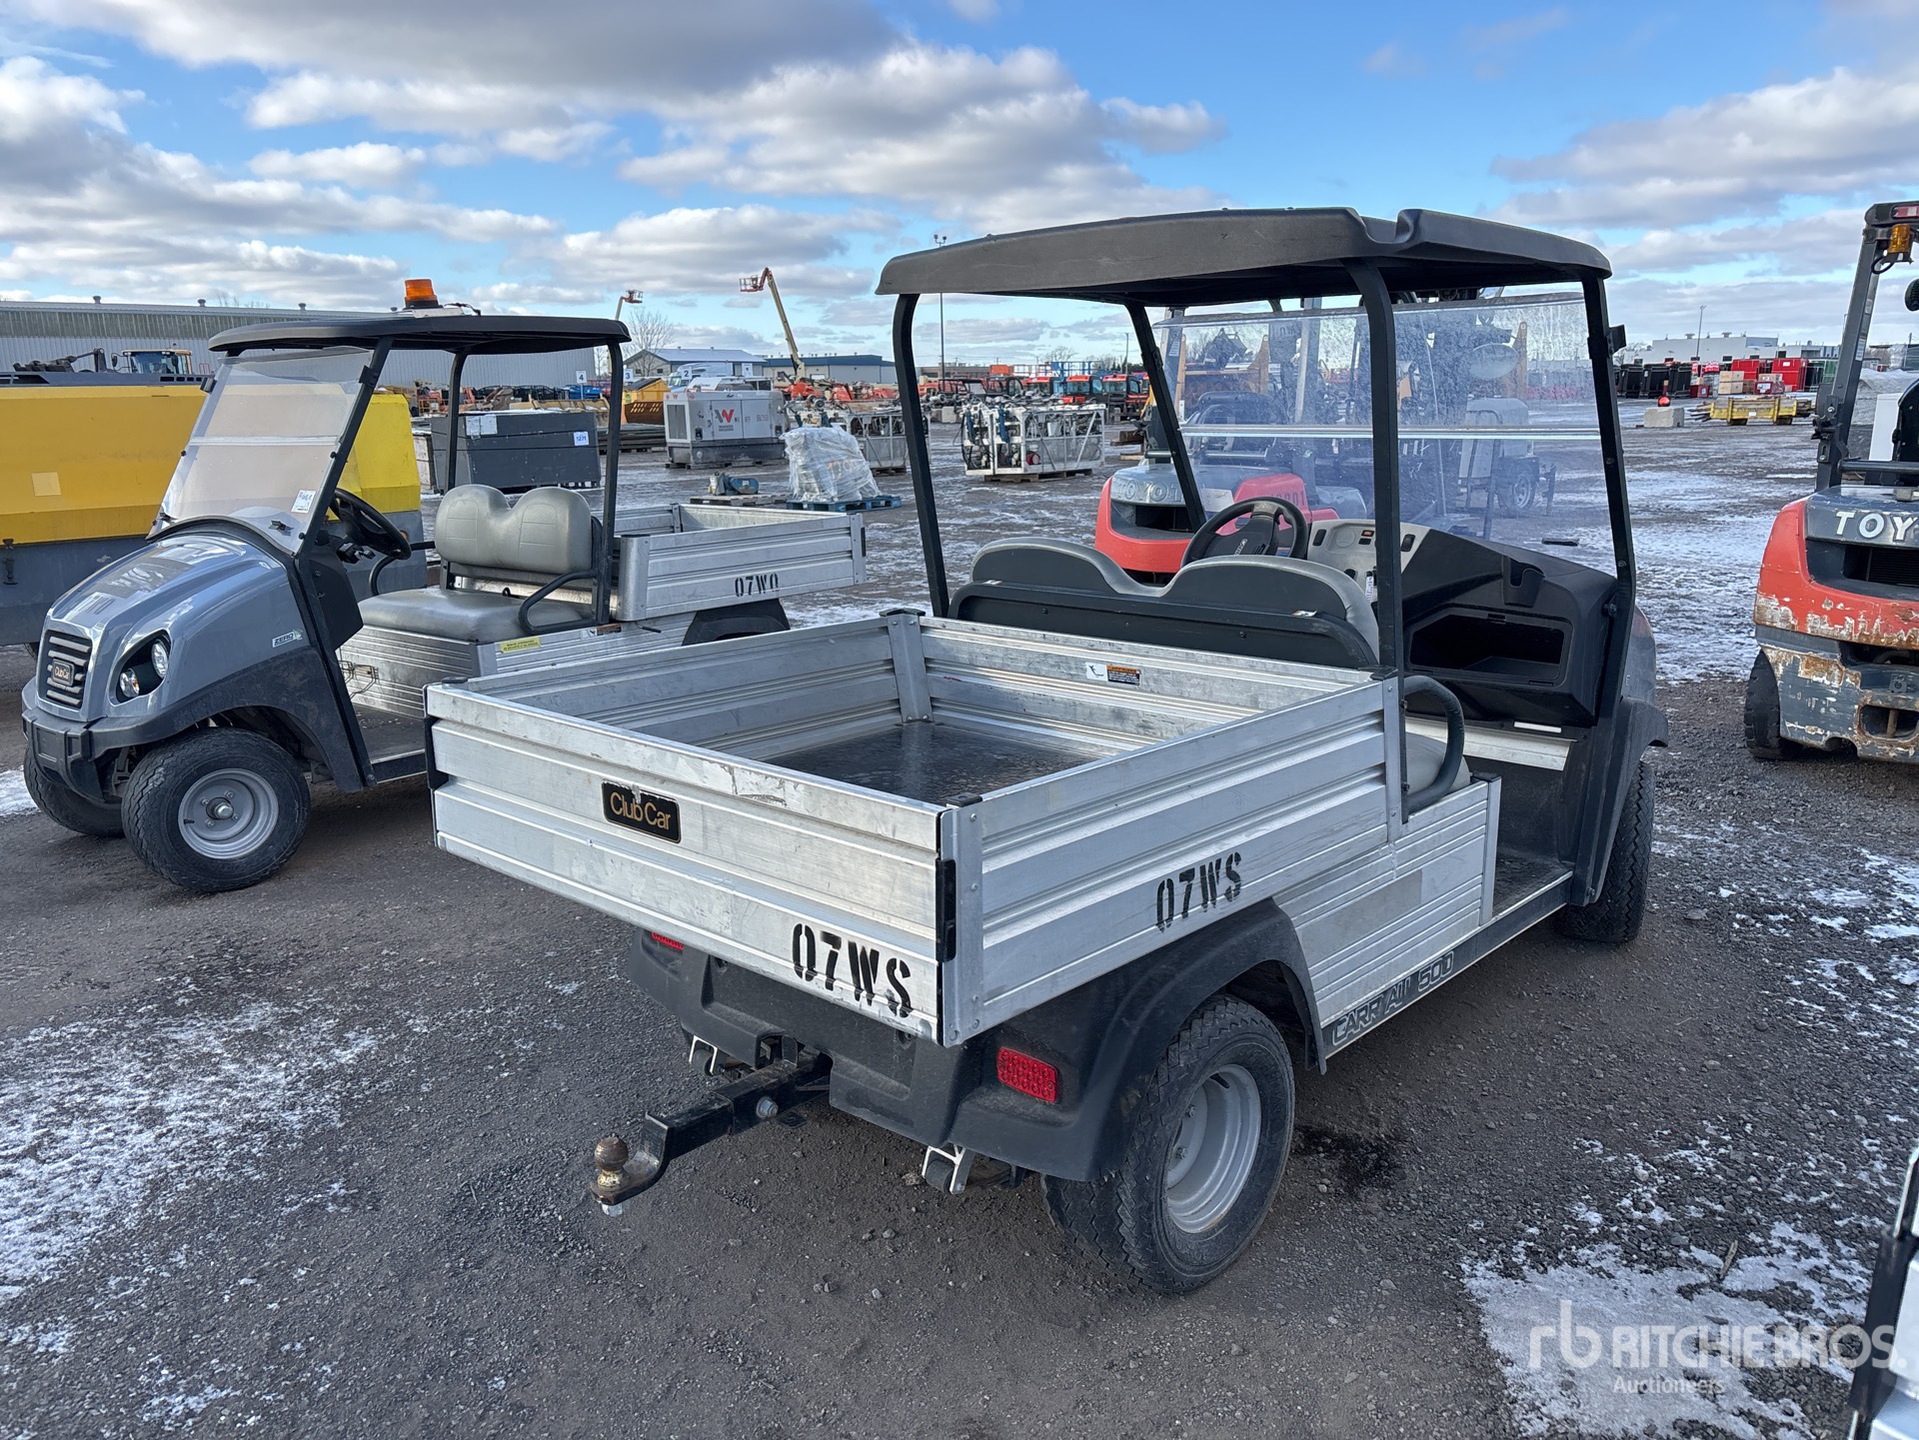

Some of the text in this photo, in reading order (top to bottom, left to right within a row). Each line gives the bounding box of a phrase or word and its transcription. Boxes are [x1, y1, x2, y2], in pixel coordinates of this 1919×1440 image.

[625, 372, 631, 380] 3
[683, 370, 690, 378] 2
[1117, 480, 1184, 503] TOYOT
[1835, 510, 1919, 542] TOY
[610, 791, 671, 830] Club Car
[1156, 852, 1242, 933] 07WS
[792, 923, 913, 1019] 07WS
[1417, 950, 1454, 992] 500
